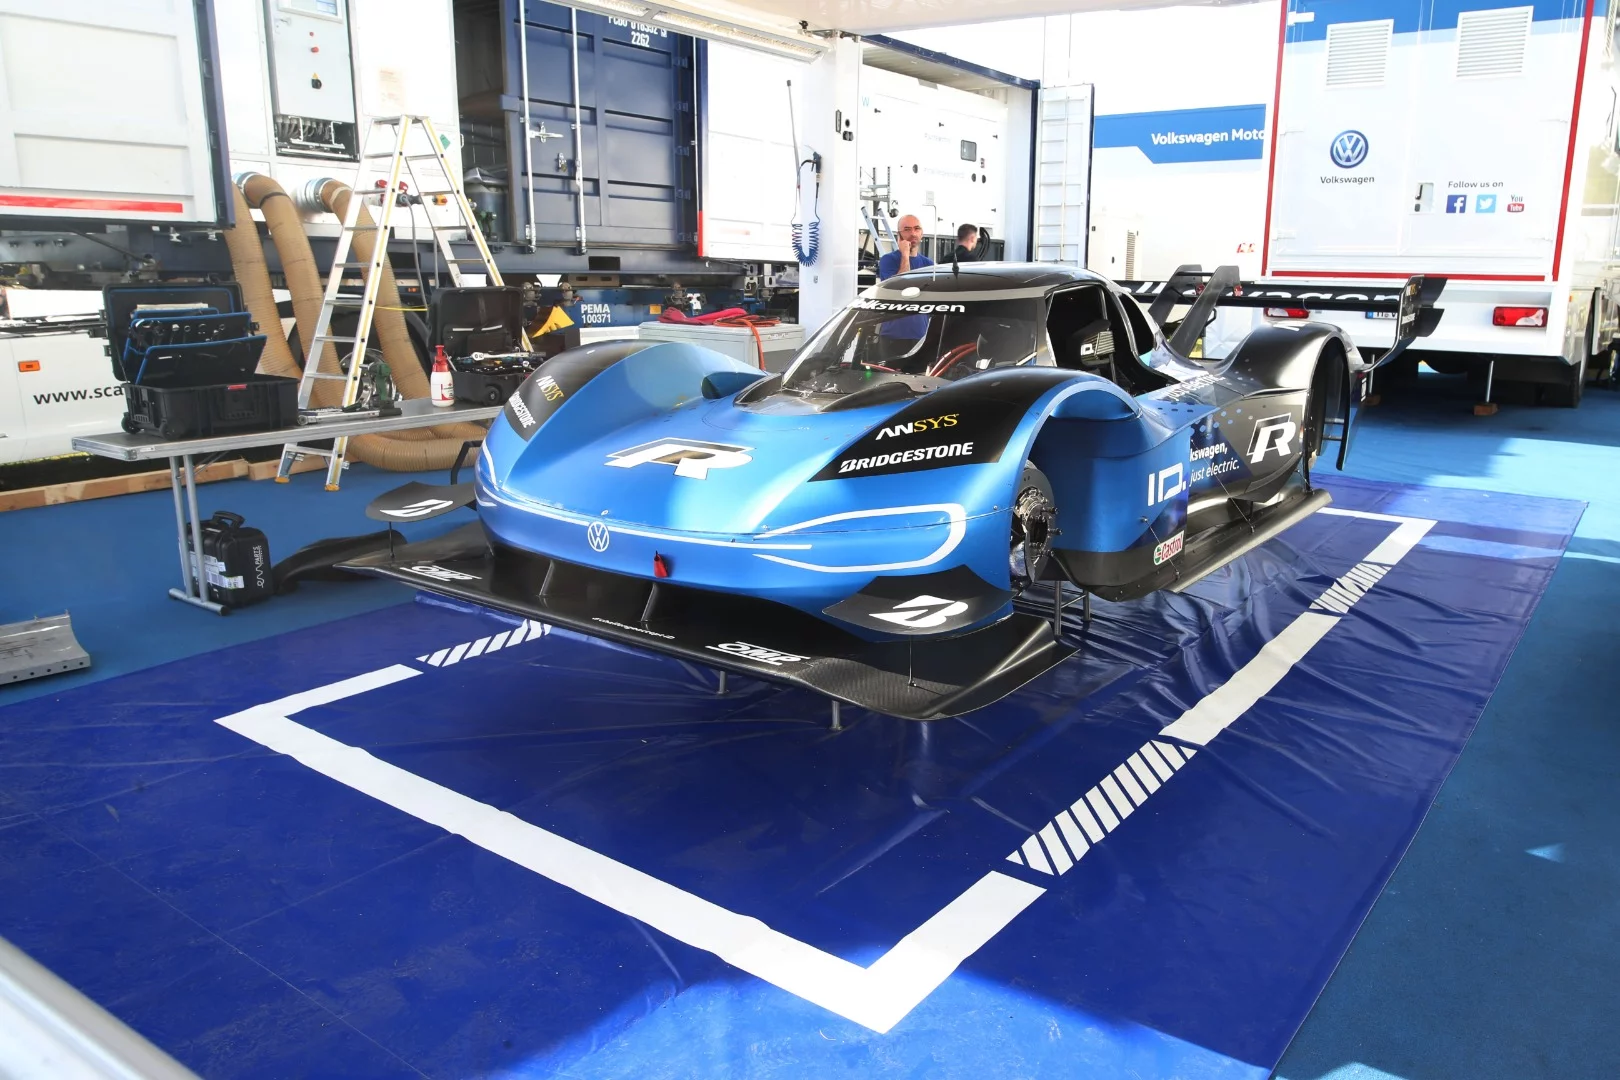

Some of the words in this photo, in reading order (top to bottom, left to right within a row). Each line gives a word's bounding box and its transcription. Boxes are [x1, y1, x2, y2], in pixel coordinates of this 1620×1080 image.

[1151, 131, 1229, 146] Volkswagen
[1320, 176, 1375, 185] Volkswagen
[580, 304, 611, 314] PEMA
[582, 314, 611, 324] 100371
[33, 385, 124, 405] www.sca
[875, 413, 959, 440] ANSYS
[1246, 412, 1297, 464] R
[838, 441, 974, 474] BRIDGESTONE
[1189, 468, 1205, 487] just
[1206, 457, 1240, 480] electric.
[1161, 533, 1183, 560] Castrol
[714, 642, 803, 663] OMP
